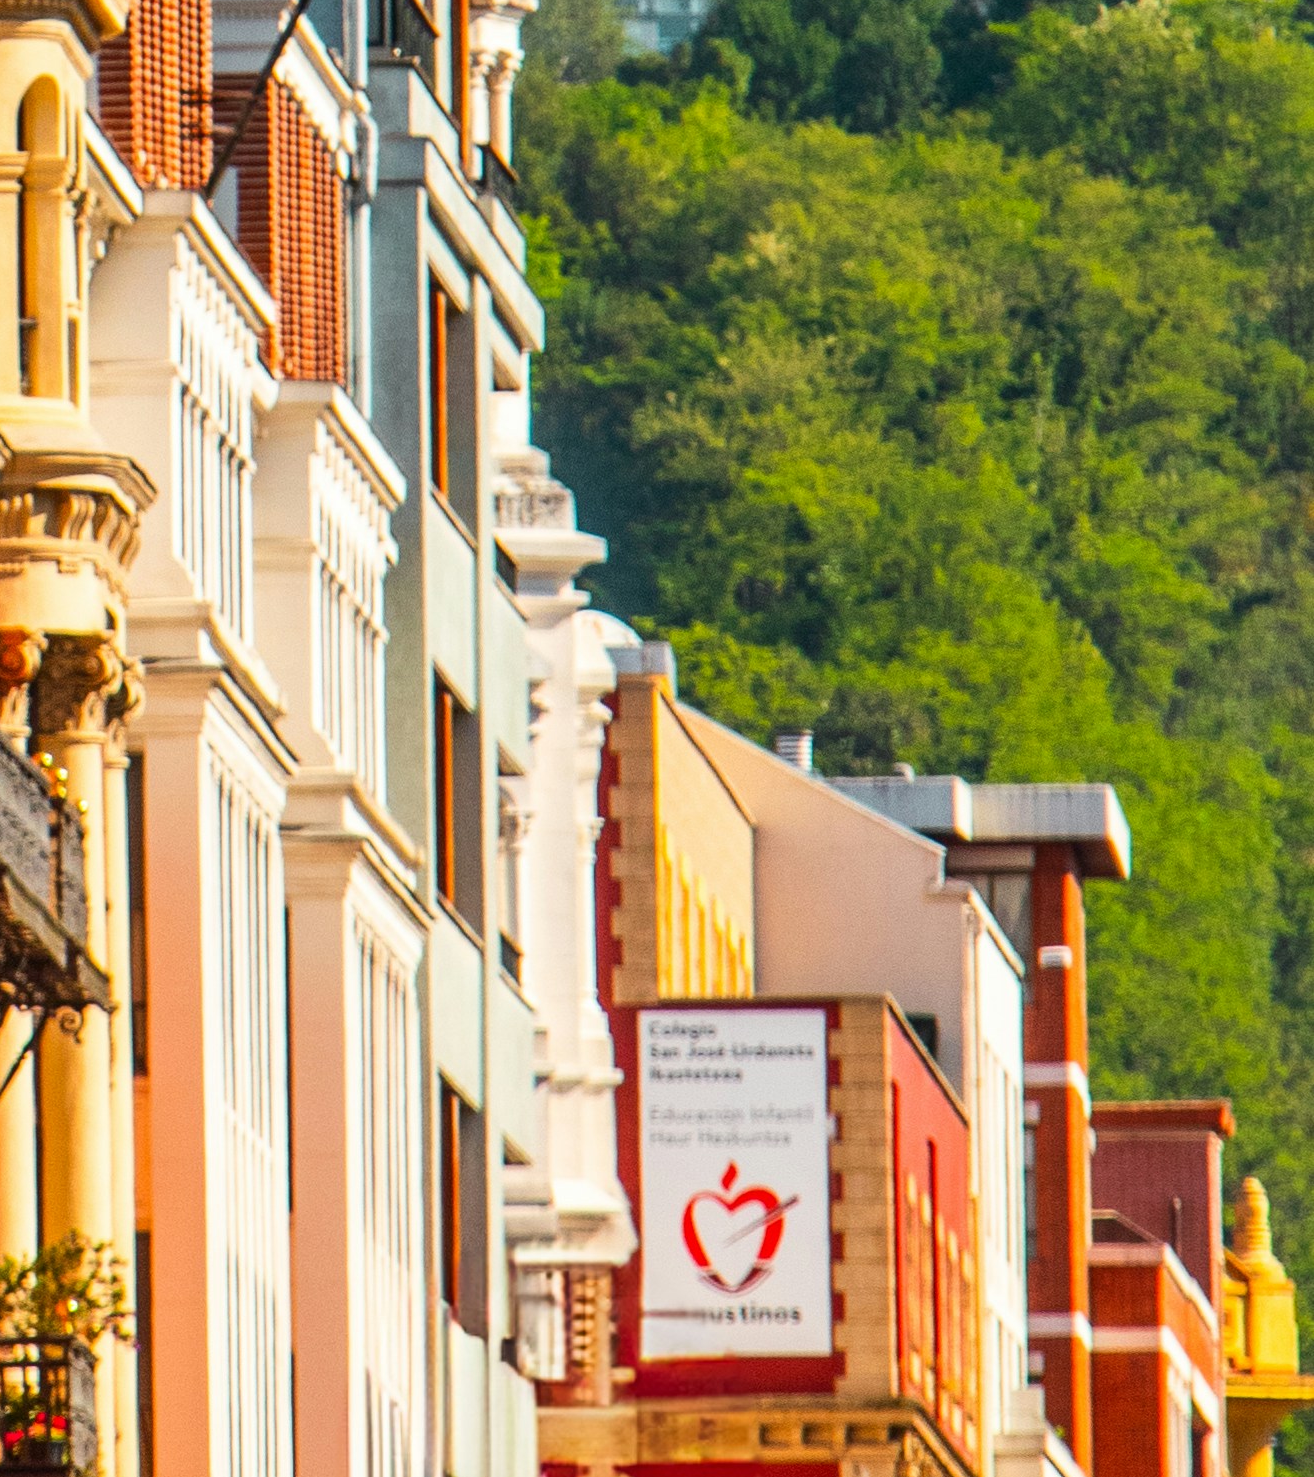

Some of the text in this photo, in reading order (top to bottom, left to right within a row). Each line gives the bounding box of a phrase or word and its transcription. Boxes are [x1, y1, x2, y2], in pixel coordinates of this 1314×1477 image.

[650, 1021, 716, 1039] Colegio
[650, 1043, 680, 1058] San
[681, 1302, 801, 1324] ustinos
